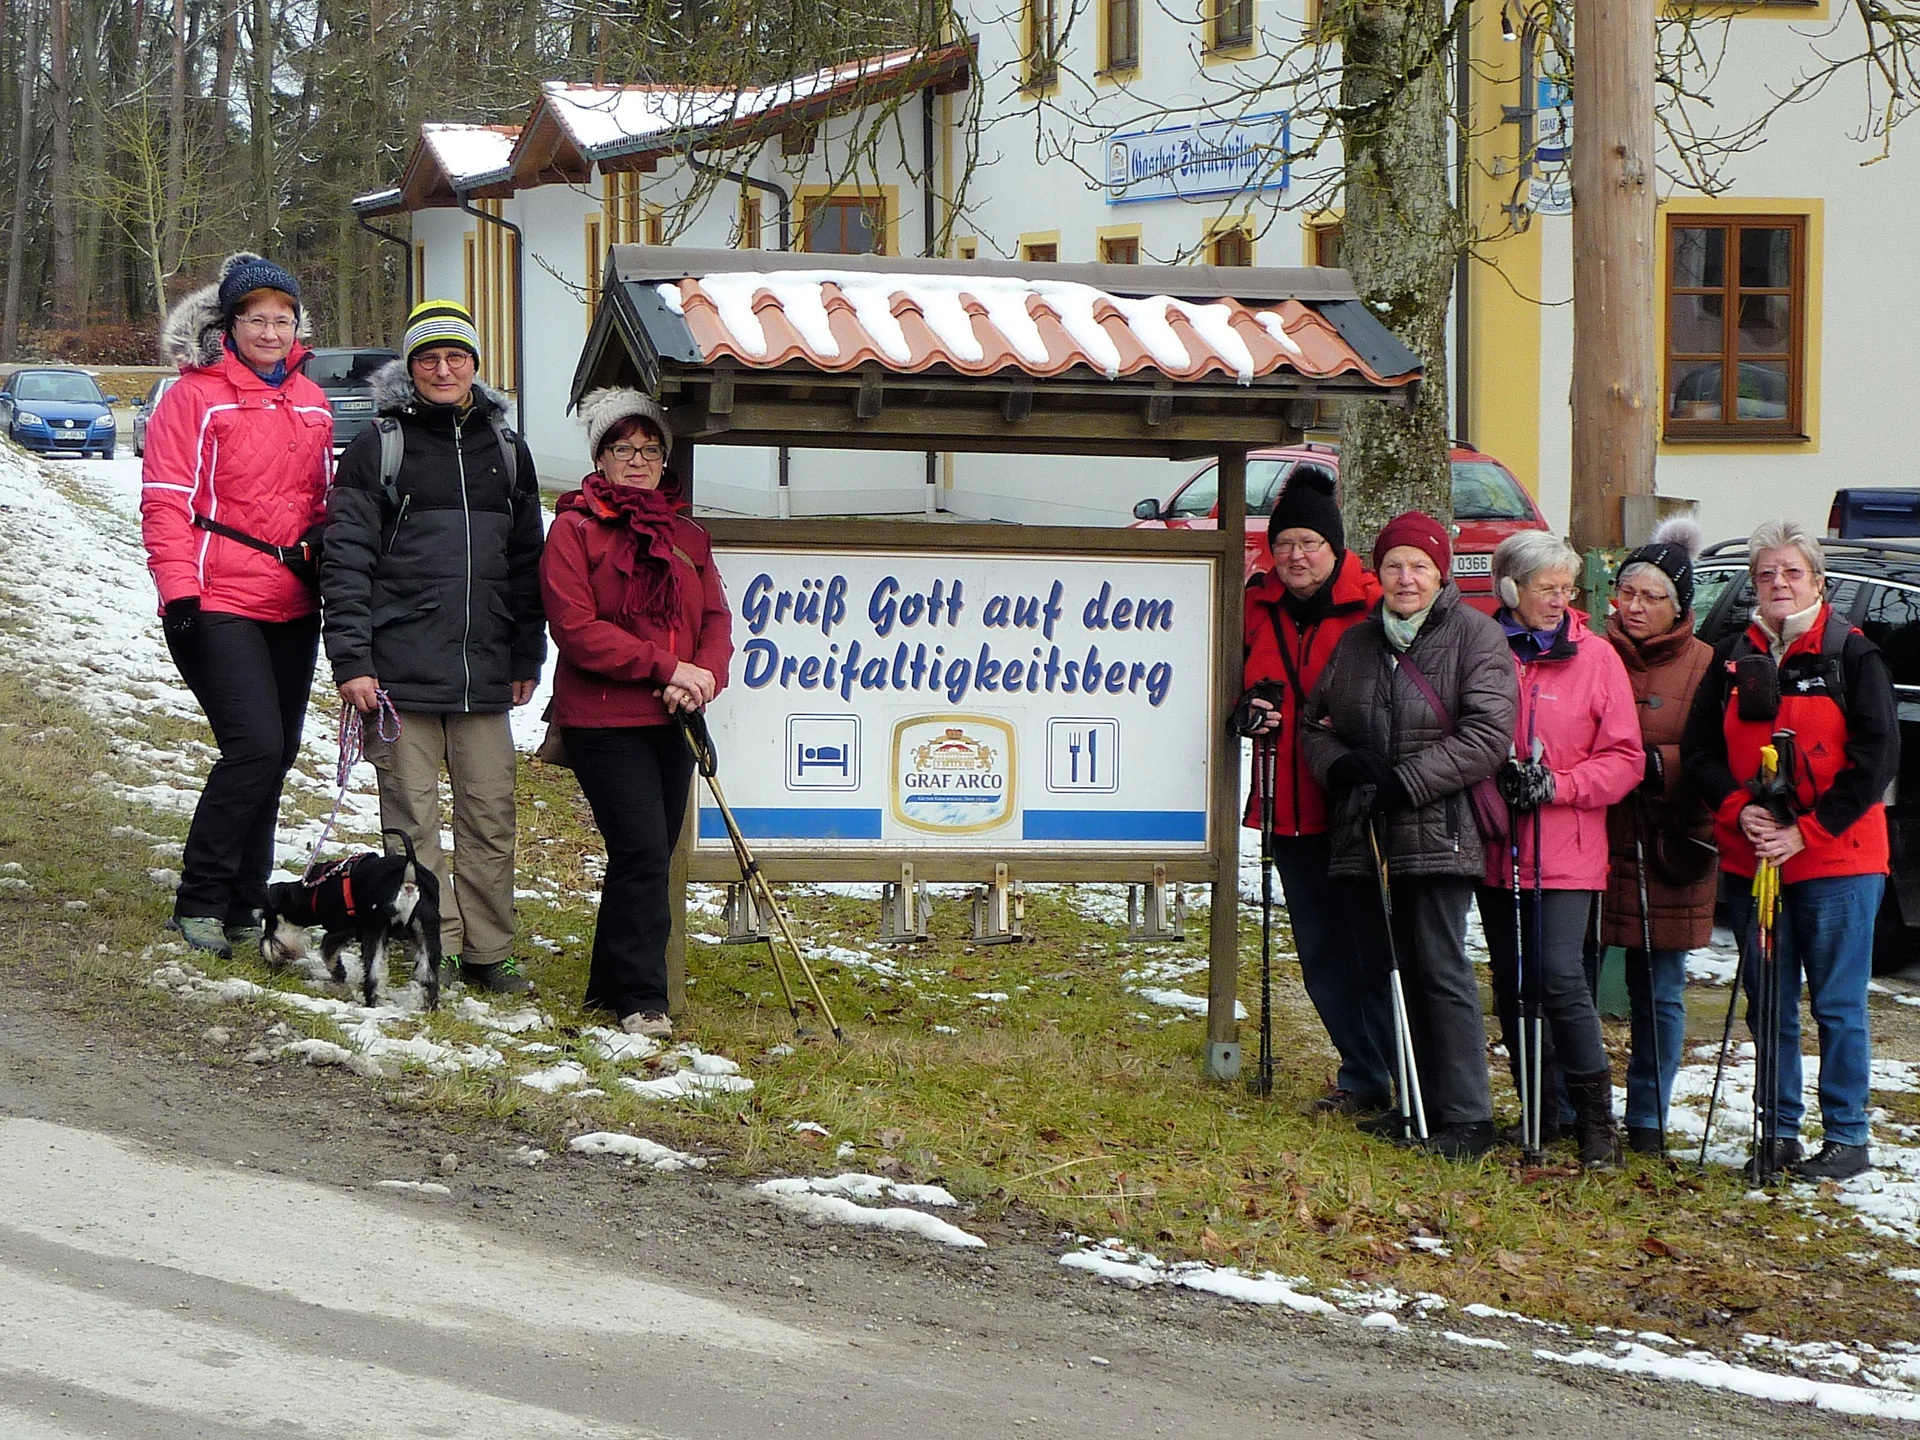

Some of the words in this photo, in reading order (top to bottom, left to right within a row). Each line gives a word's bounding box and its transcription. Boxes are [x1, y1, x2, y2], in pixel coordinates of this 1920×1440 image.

[1132, 144, 1176, 188] Gasthof
[1458, 557, 1488, 570] 0366
[742, 573, 849, 637] Grüß
[869, 576, 966, 638] Gott
[983, 579, 1064, 642] auf
[1083, 580, 1175, 632] dem
[743, 638, 1174, 708] Dreifaltigkeitsberg
[905, 773, 952, 788] GRAF
[955, 774, 1003, 789] ARCO
